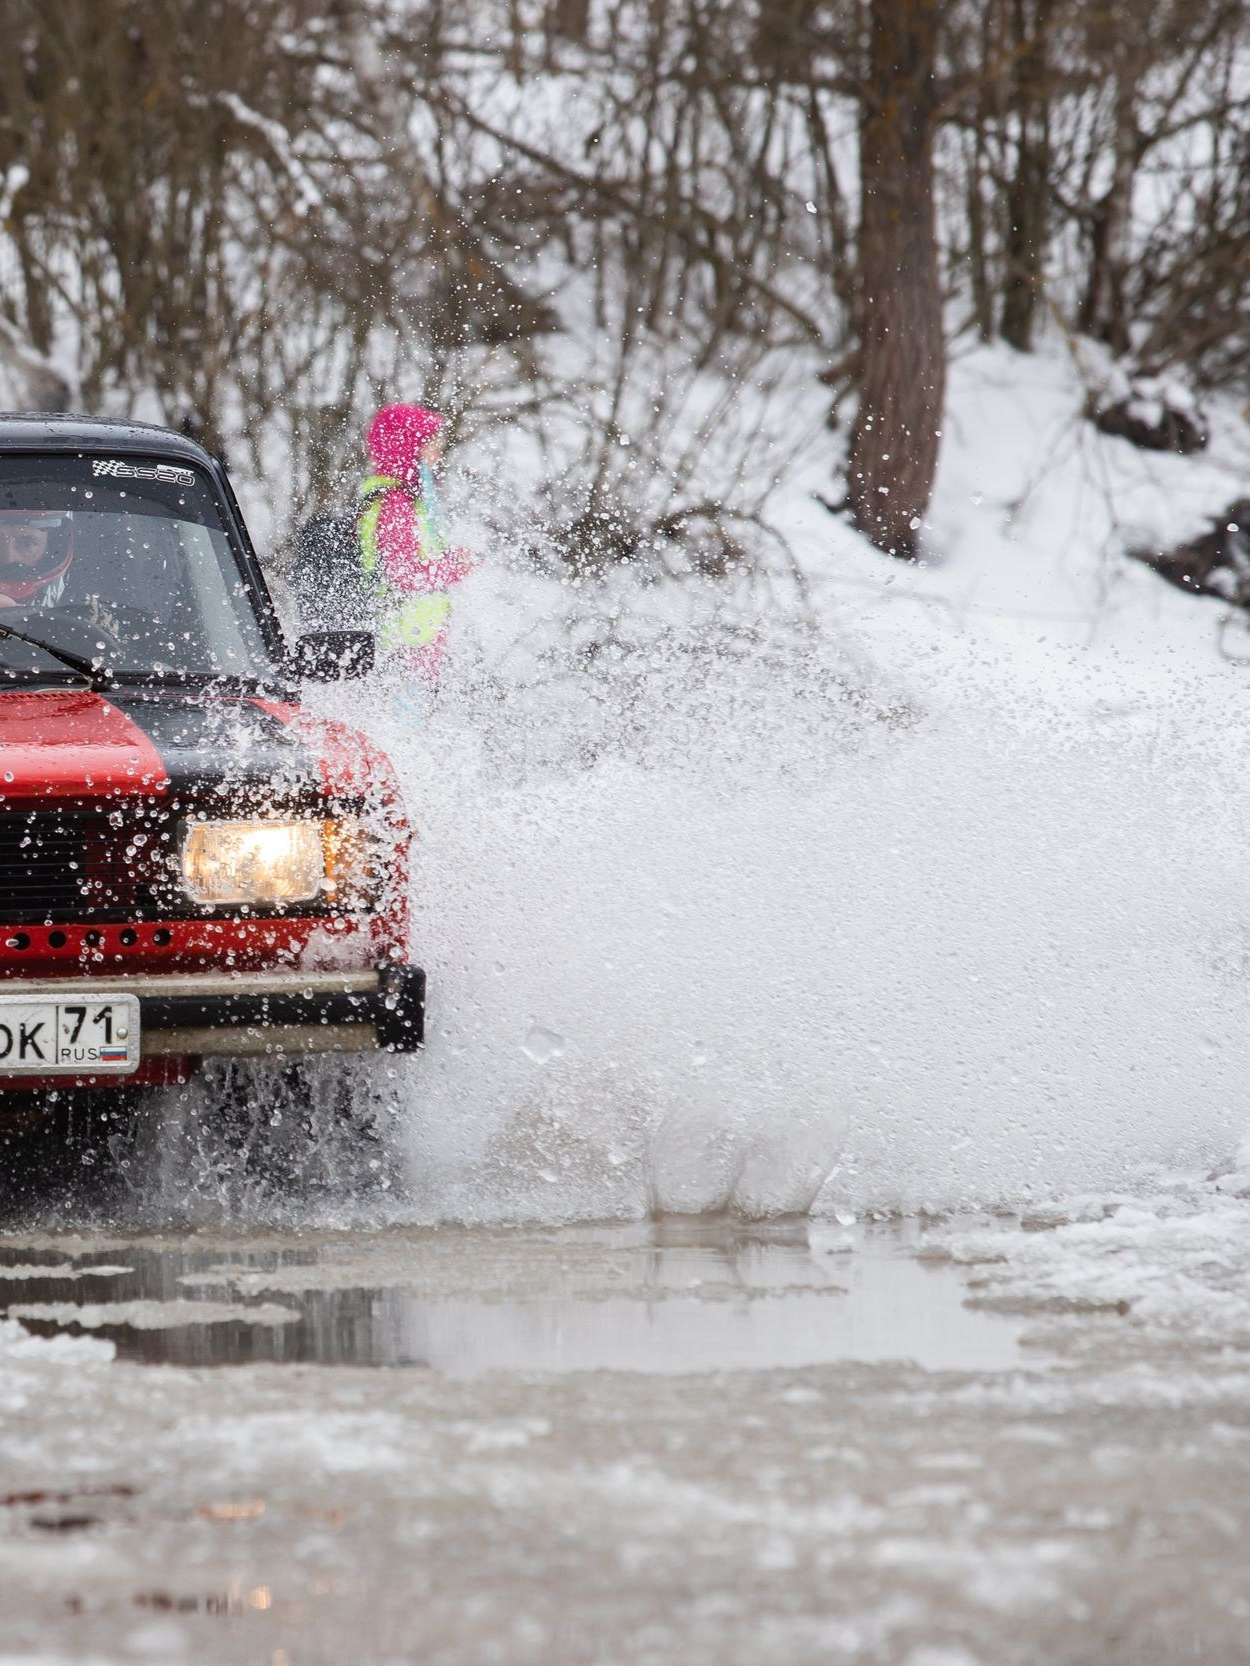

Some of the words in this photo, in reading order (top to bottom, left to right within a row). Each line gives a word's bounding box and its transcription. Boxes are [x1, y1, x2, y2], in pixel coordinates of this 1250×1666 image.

[116, 465, 195, 486] SS20
[64, 1006, 113, 1045] 71
[61, 1047, 98, 1062] RUS
